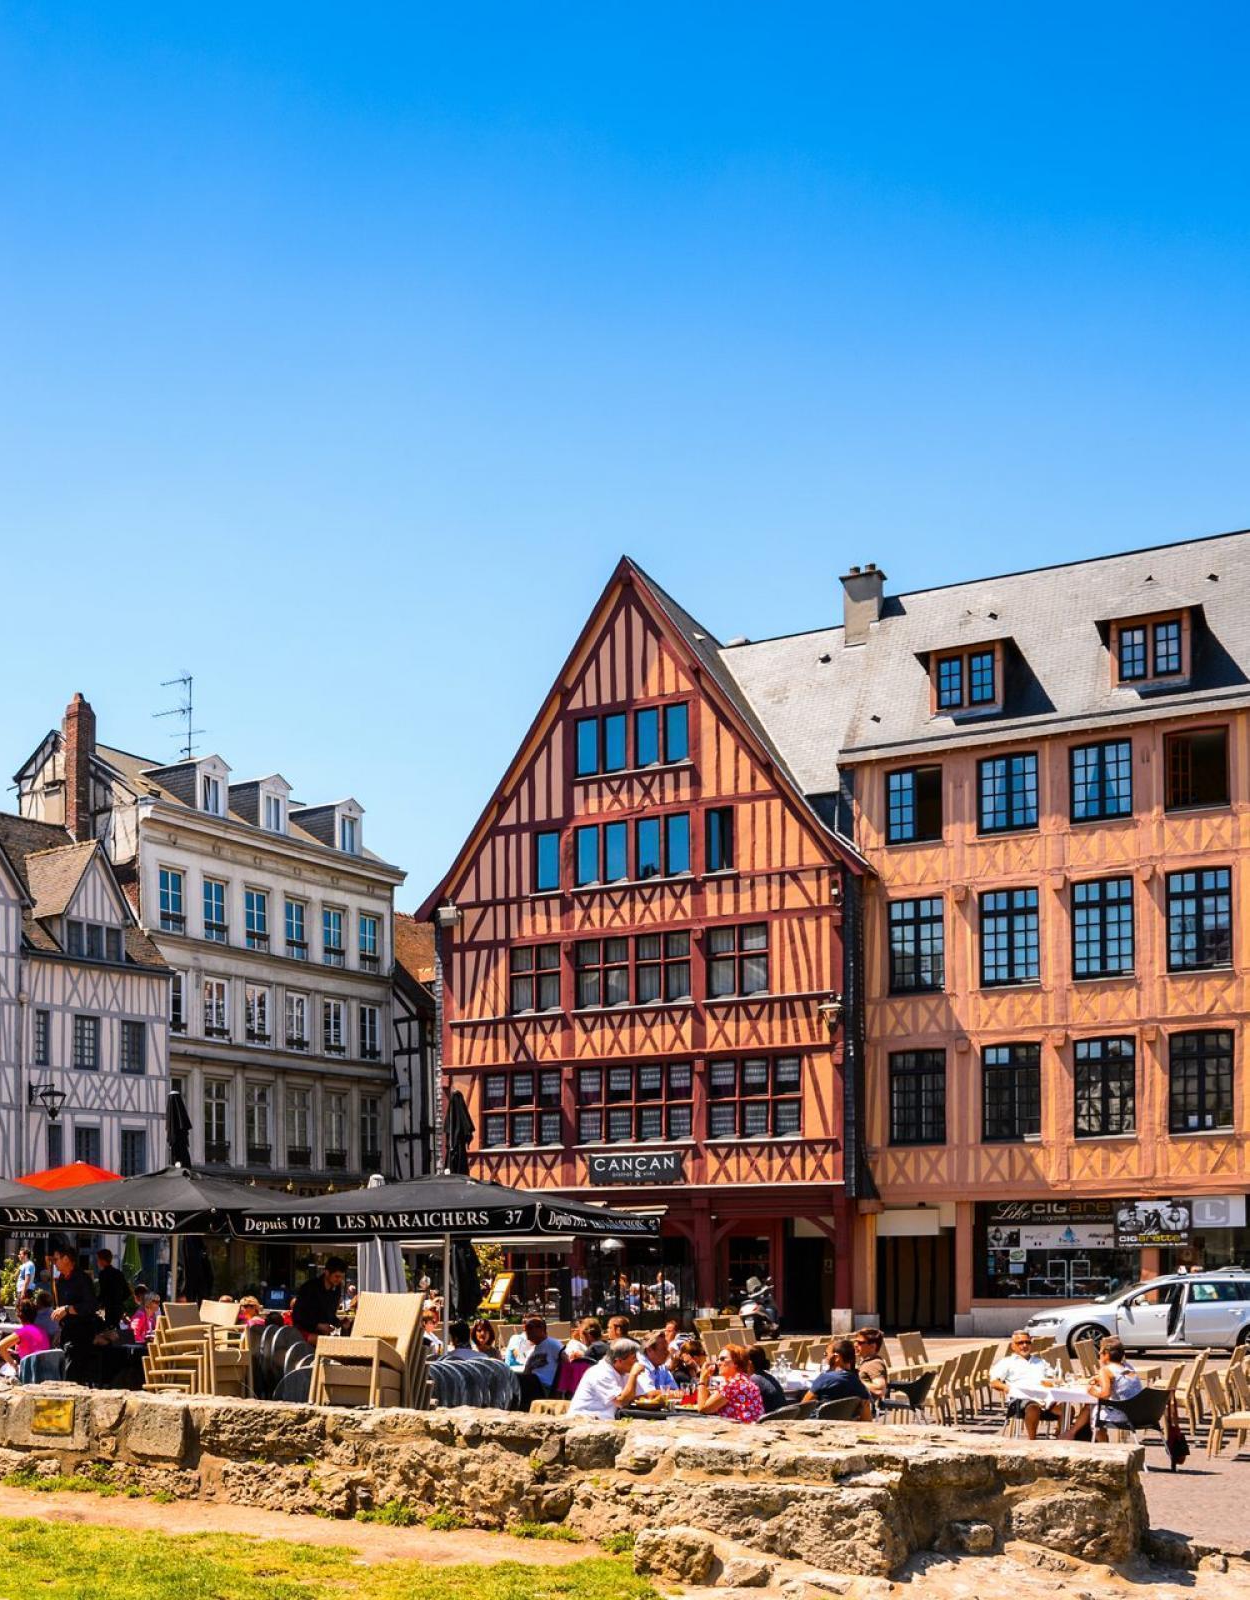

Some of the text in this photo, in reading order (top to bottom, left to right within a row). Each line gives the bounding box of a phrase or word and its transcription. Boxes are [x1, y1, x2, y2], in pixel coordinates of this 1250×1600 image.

[594, 1157, 675, 1172] CANCAN
[4, 1208, 176, 1230] LES MARAICHERS
[244, 1210, 523, 1233] Depuis 1912 LES MARAICHERS 37
